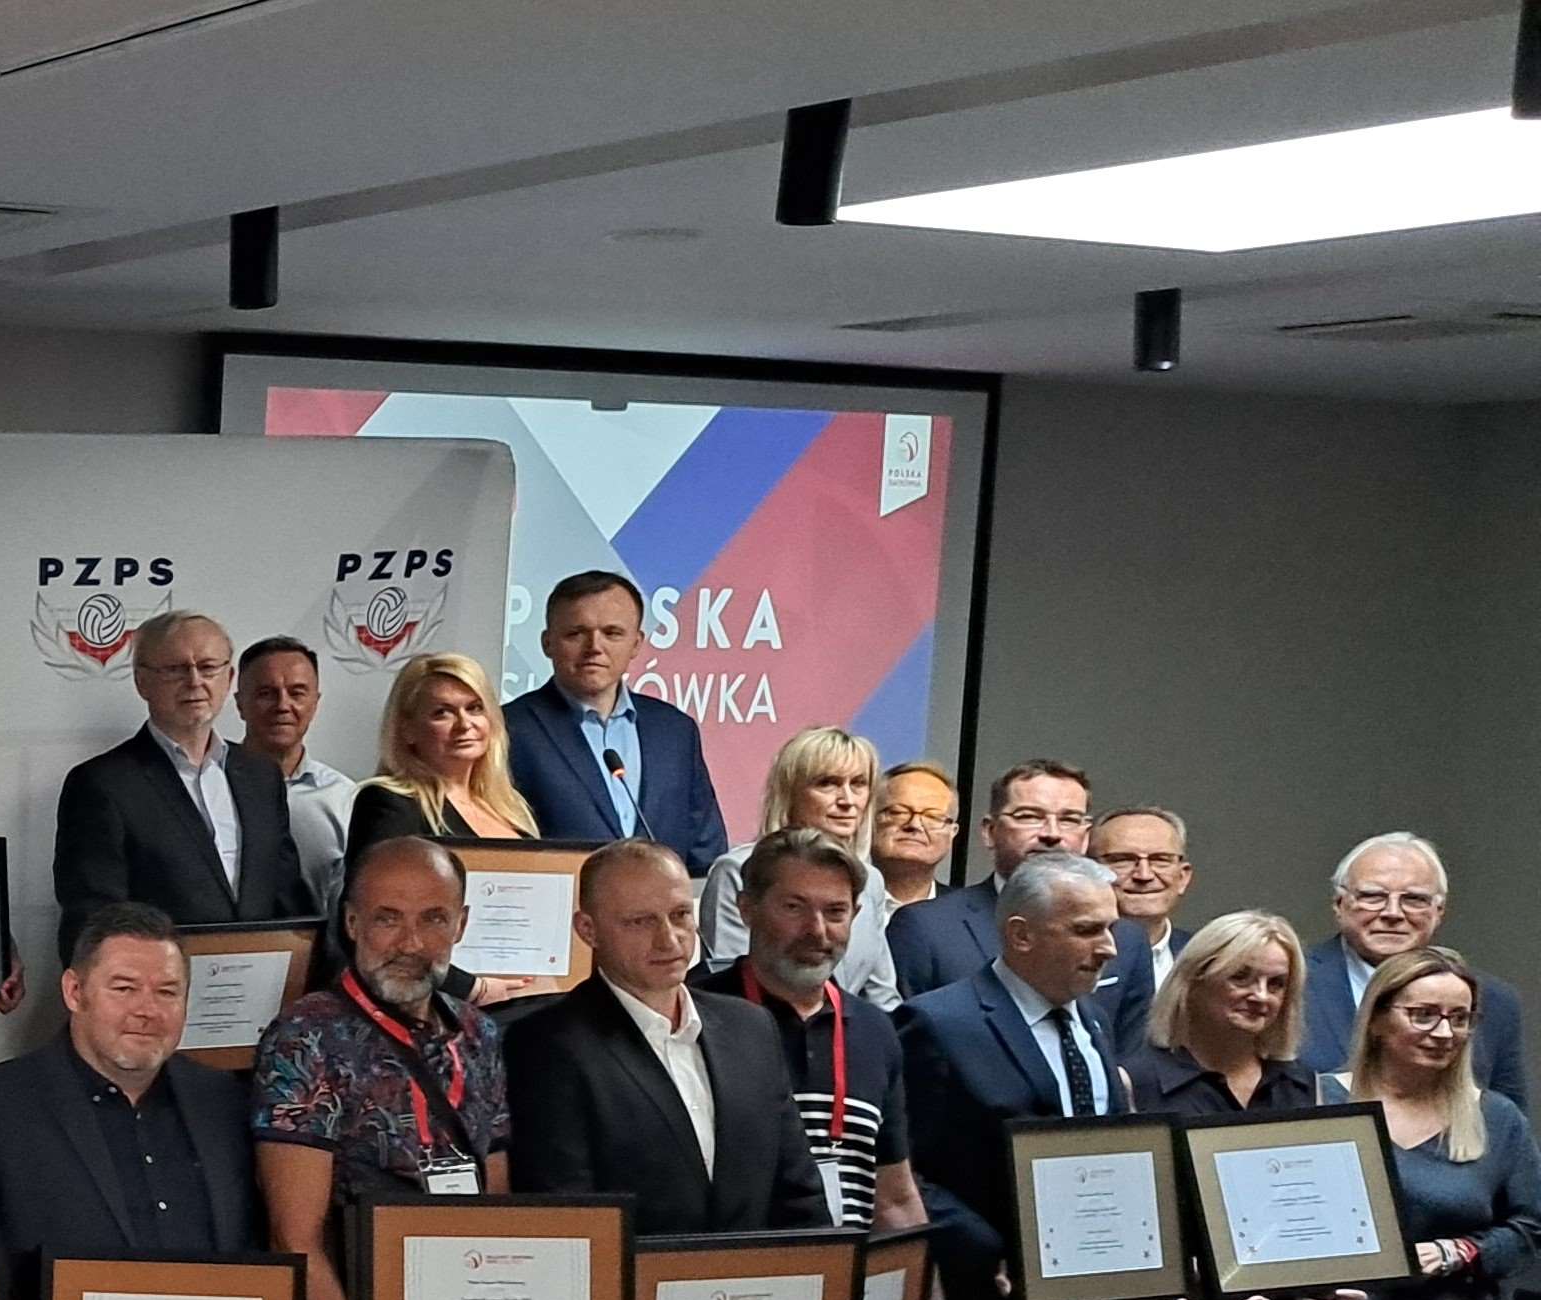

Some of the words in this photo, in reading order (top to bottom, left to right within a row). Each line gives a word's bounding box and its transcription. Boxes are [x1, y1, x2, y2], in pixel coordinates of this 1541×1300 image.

[38, 556, 174, 587] PZPS
[335, 548, 455, 583] PZPS
[505, 584, 783, 651] PSKA
[501, 658, 778, 724] SIÓWKA
